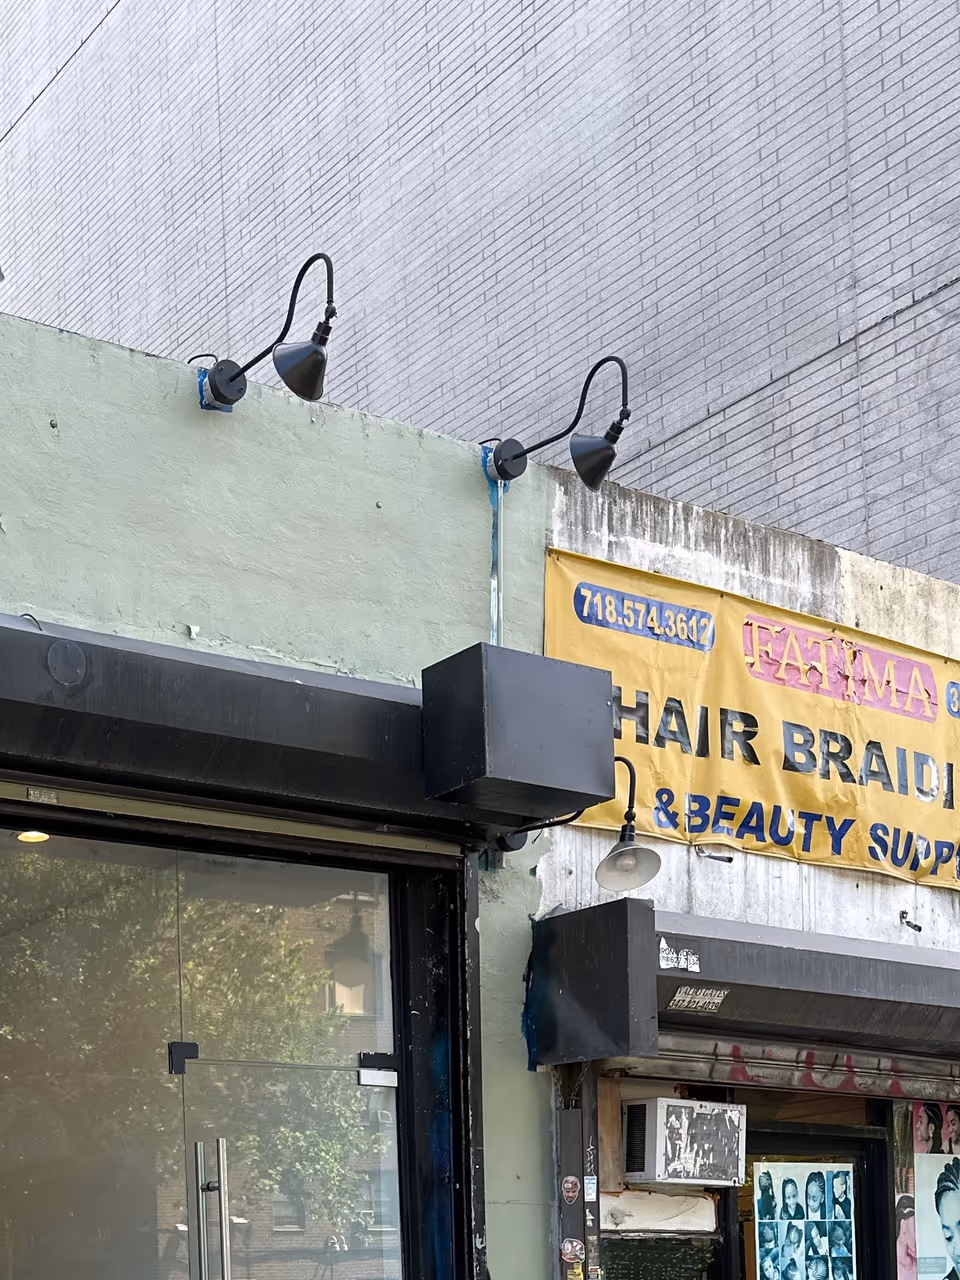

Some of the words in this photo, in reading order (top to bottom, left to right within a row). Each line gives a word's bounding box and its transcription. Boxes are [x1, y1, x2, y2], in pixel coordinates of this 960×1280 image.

[579, 588, 713, 645] 718.574.3612
[749, 622, 934, 718] FATIMA
[613, 685, 760, 766] HAIR
